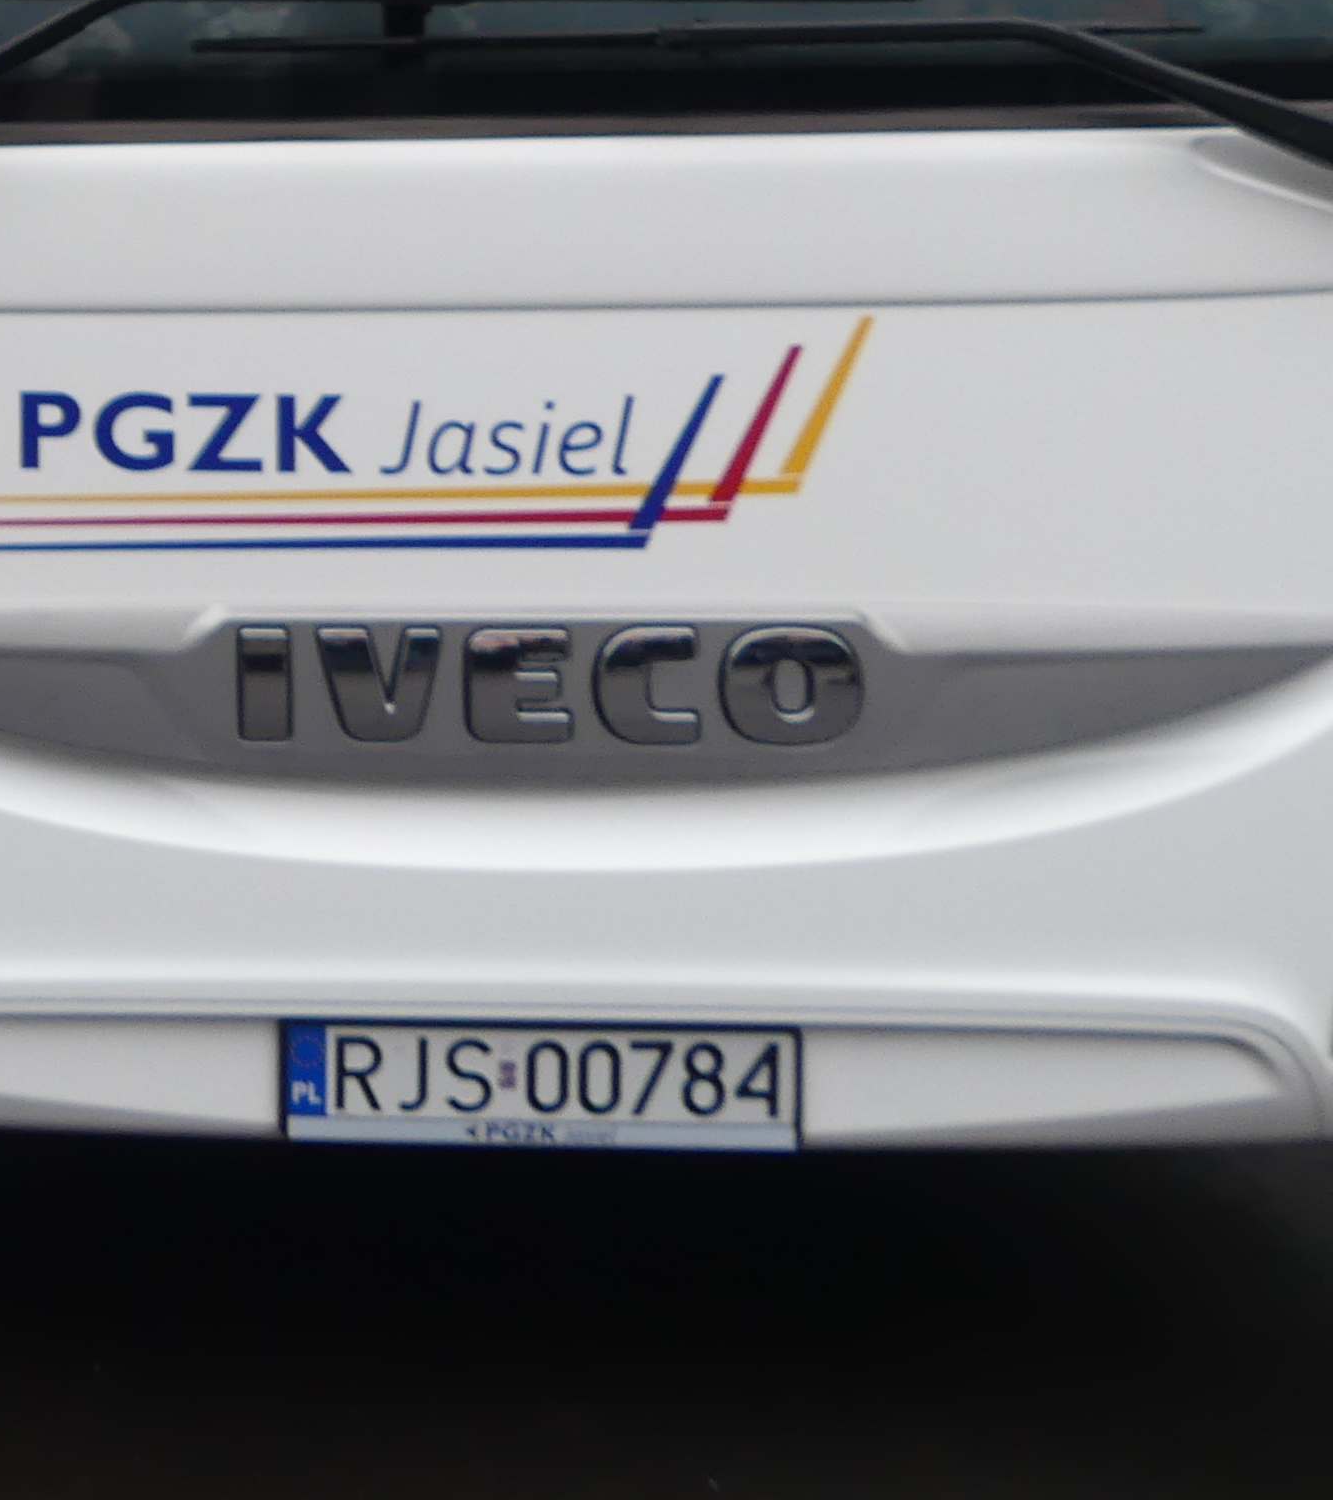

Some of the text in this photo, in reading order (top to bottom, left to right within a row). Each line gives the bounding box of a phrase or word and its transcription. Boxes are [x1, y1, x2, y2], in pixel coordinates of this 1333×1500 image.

[17, 389, 637, 478] PGZK Jasiel
[233, 621, 870, 749] IVECO
[291, 1080, 322, 1105] PL
[333, 1033, 782, 1119] RJS 00784
